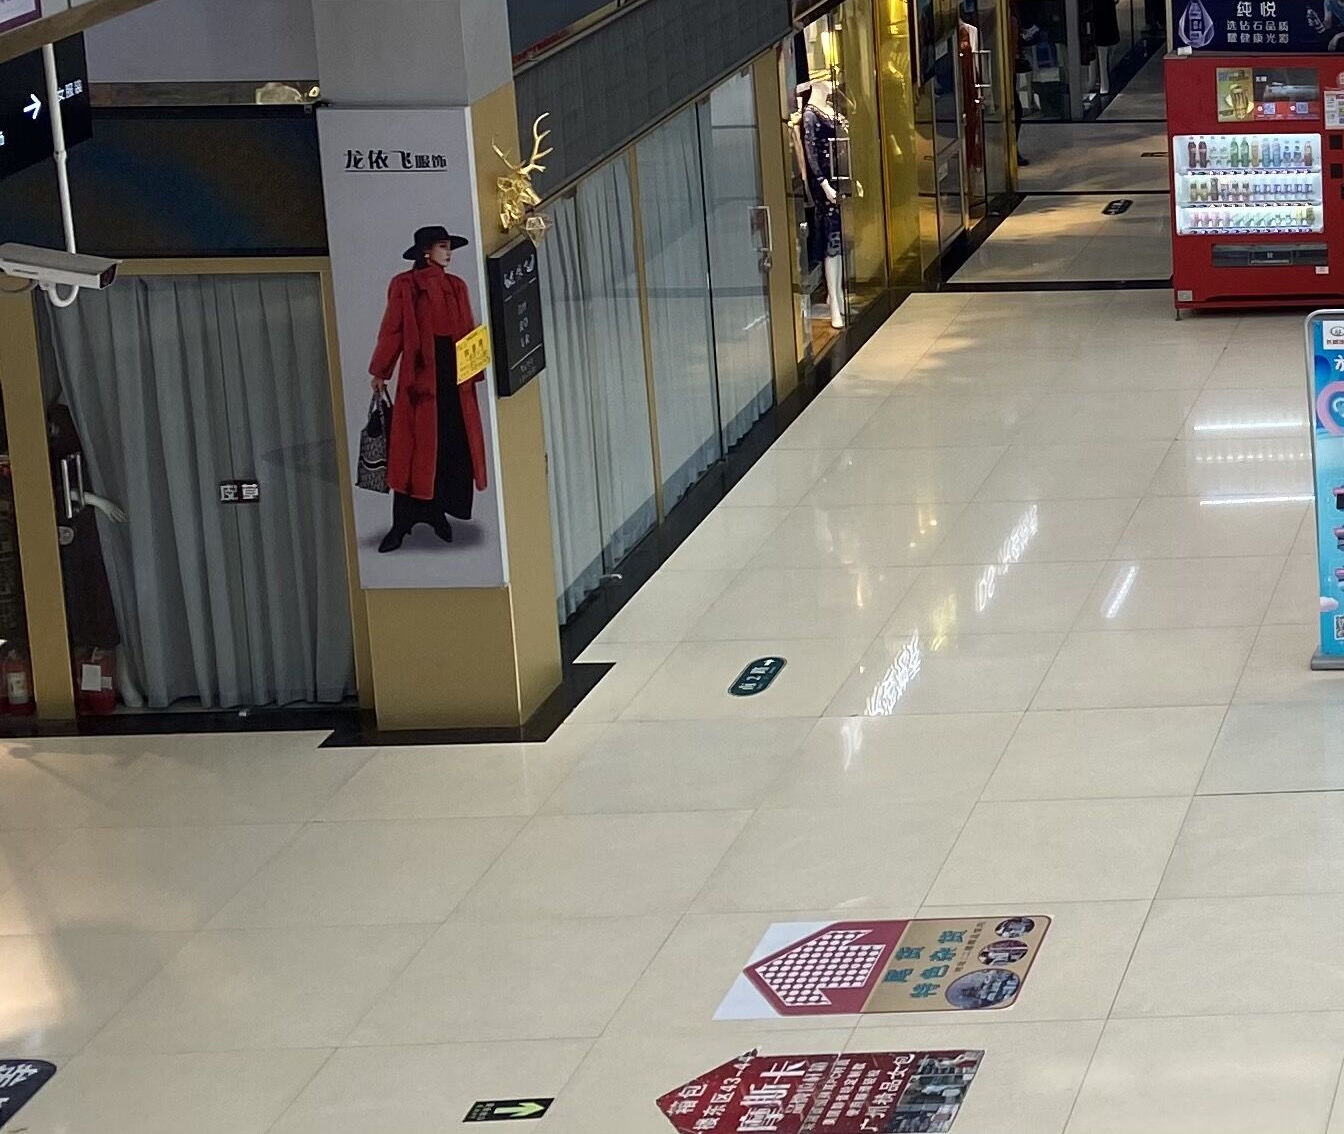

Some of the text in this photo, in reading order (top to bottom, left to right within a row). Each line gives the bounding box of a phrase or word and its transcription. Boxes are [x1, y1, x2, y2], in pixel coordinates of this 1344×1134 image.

[1236, 1, 1277, 17] 纯悦
[1226, 19, 1289, 32] 选钻石品质
[345, 150, 447, 169] 龙依飞服饰
[736, 1060, 807, 1132] 摩斯卡
[860, 1053, 914, 1132] 广州精品女包
